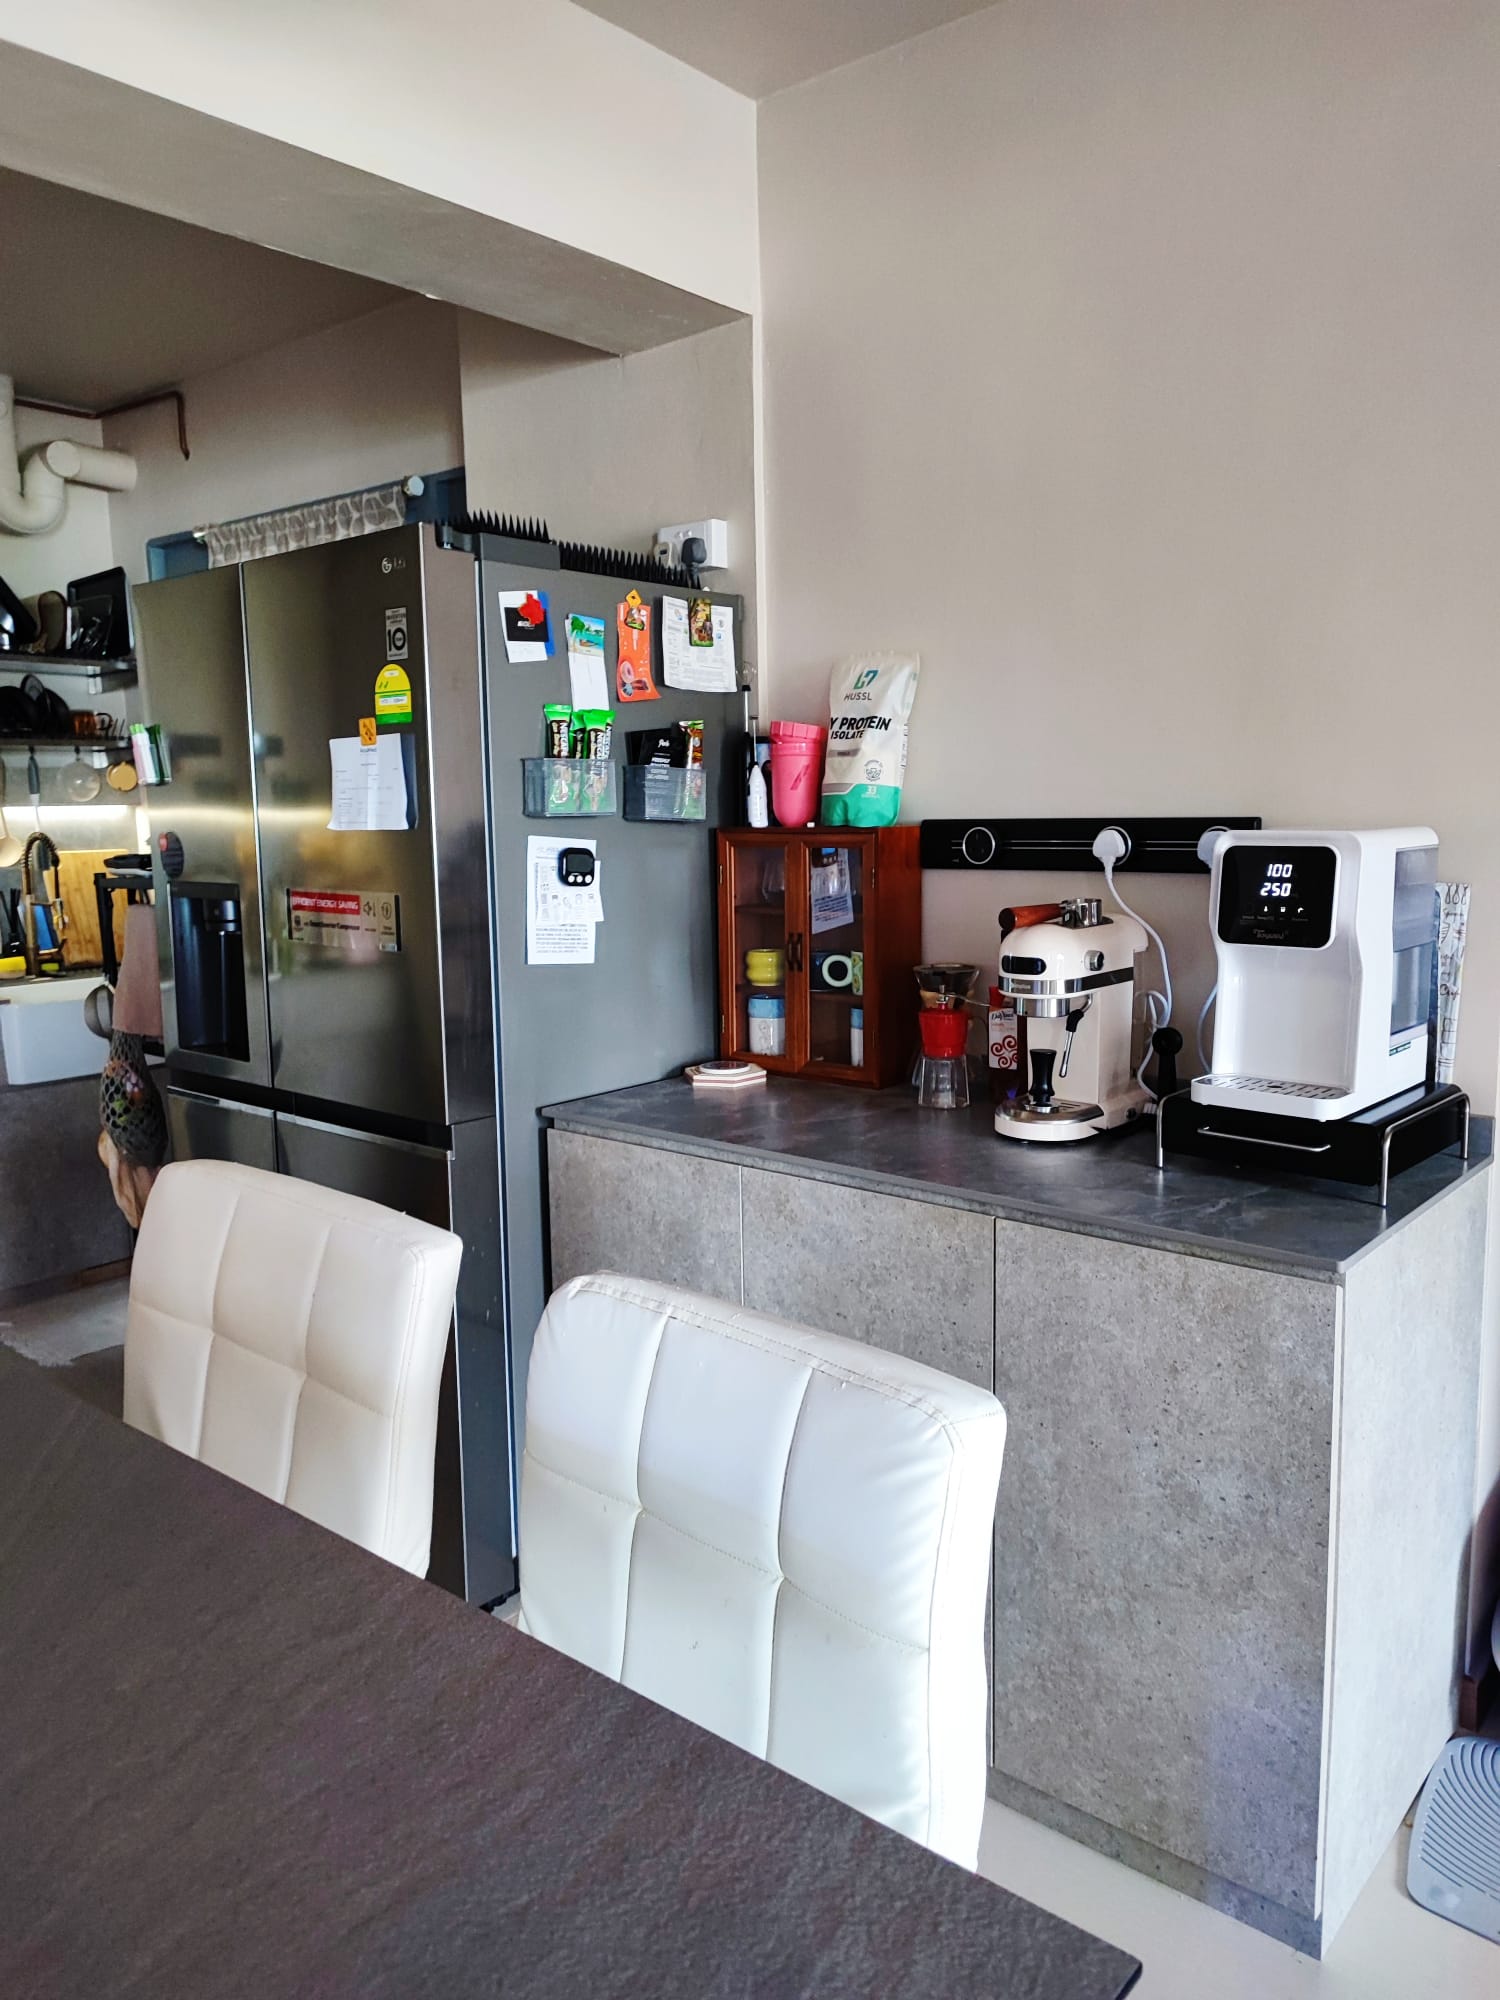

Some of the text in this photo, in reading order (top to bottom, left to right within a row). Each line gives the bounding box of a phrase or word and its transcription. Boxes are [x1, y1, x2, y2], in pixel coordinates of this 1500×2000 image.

[387, 627, 406, 652] 10
[843, 691, 873, 702] HUSSL
[839, 715, 892, 731] PROTEIN
[830, 730, 864, 740] ISOLATE
[1267, 863, 1293, 878] 100
[1260, 882, 1292, 897] 250
